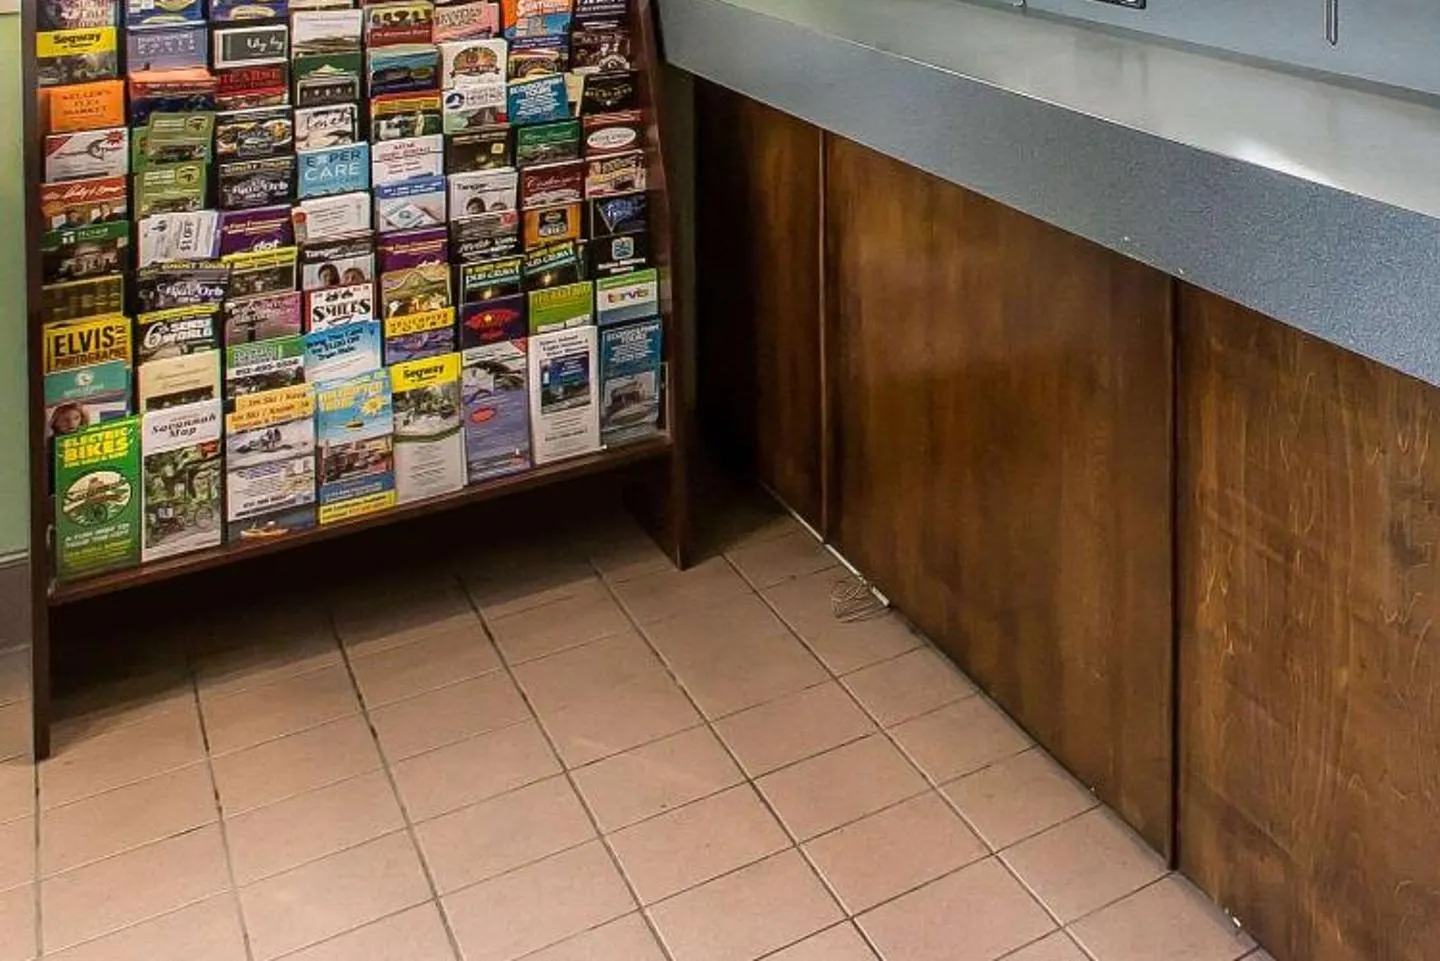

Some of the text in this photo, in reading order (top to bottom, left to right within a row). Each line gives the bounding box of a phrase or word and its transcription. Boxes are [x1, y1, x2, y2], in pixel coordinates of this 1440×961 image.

[53, 32, 102, 45] Segway
[305, 162, 361, 181] CARE
[198, 284, 224, 297] Orb
[312, 299, 371, 322] SMILES
[54, 325, 115, 357] ELVIS
[403, 364, 445, 379] Segway
[152, 411, 218, 435] Savannah
[169, 425, 197, 439] Map
[63, 426, 129, 447] ELECTRIC
[63, 438, 129, 462] BIKES
